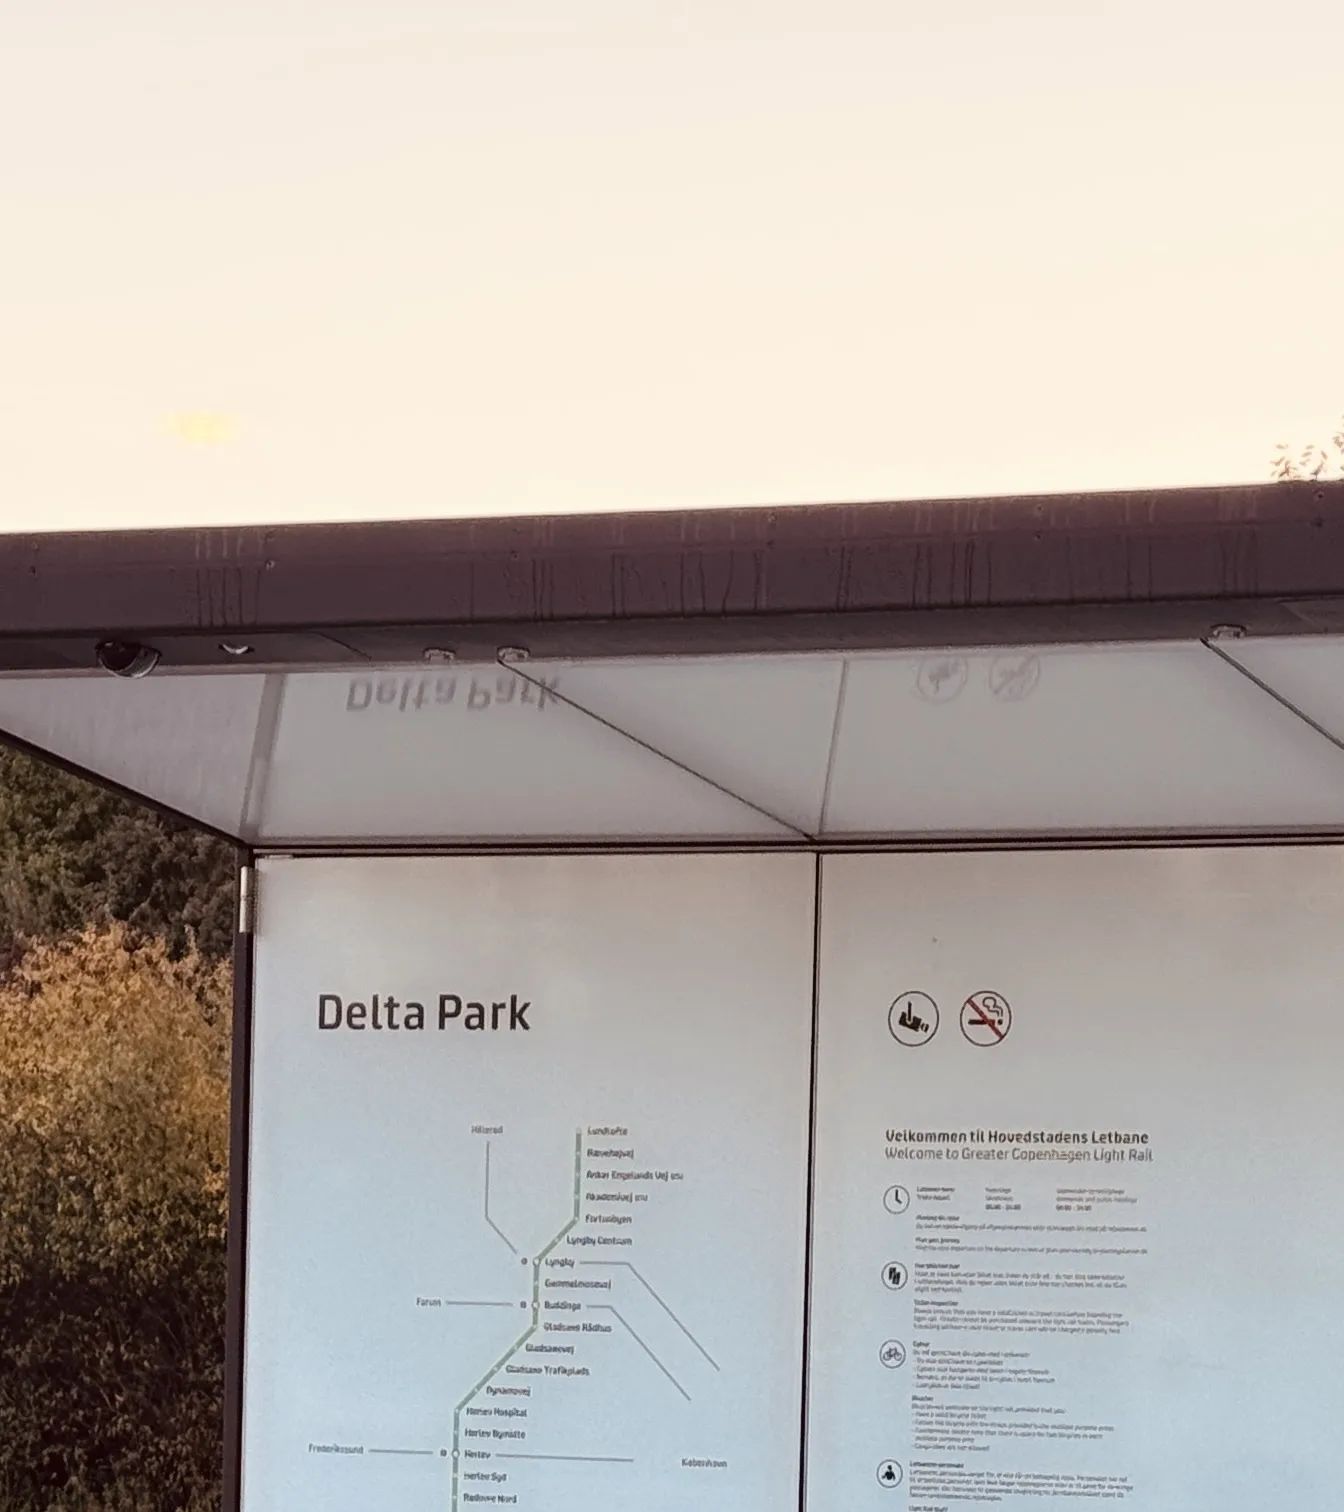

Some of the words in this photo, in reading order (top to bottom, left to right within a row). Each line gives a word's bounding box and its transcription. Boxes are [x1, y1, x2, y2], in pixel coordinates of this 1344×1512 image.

[318, 993, 425, 1031] Delta
[438, 993, 531, 1031] Park
[885, 1129, 967, 1144] Velkommen
[969, 1128, 985, 1143] til
[989, 1129, 1088, 1144] Hovedstadens
[1091, 1130, 1149, 1145] Letbane
[885, 1147, 944, 1161] Welcome
[946, 1148, 959, 1161] to
[961, 1147, 1009, 1161] Greater
[1011, 1148, 1091, 1164] Copenhagen
[1093, 1149, 1125, 1163] Light
[1129, 1149, 1154, 1162] Rail
